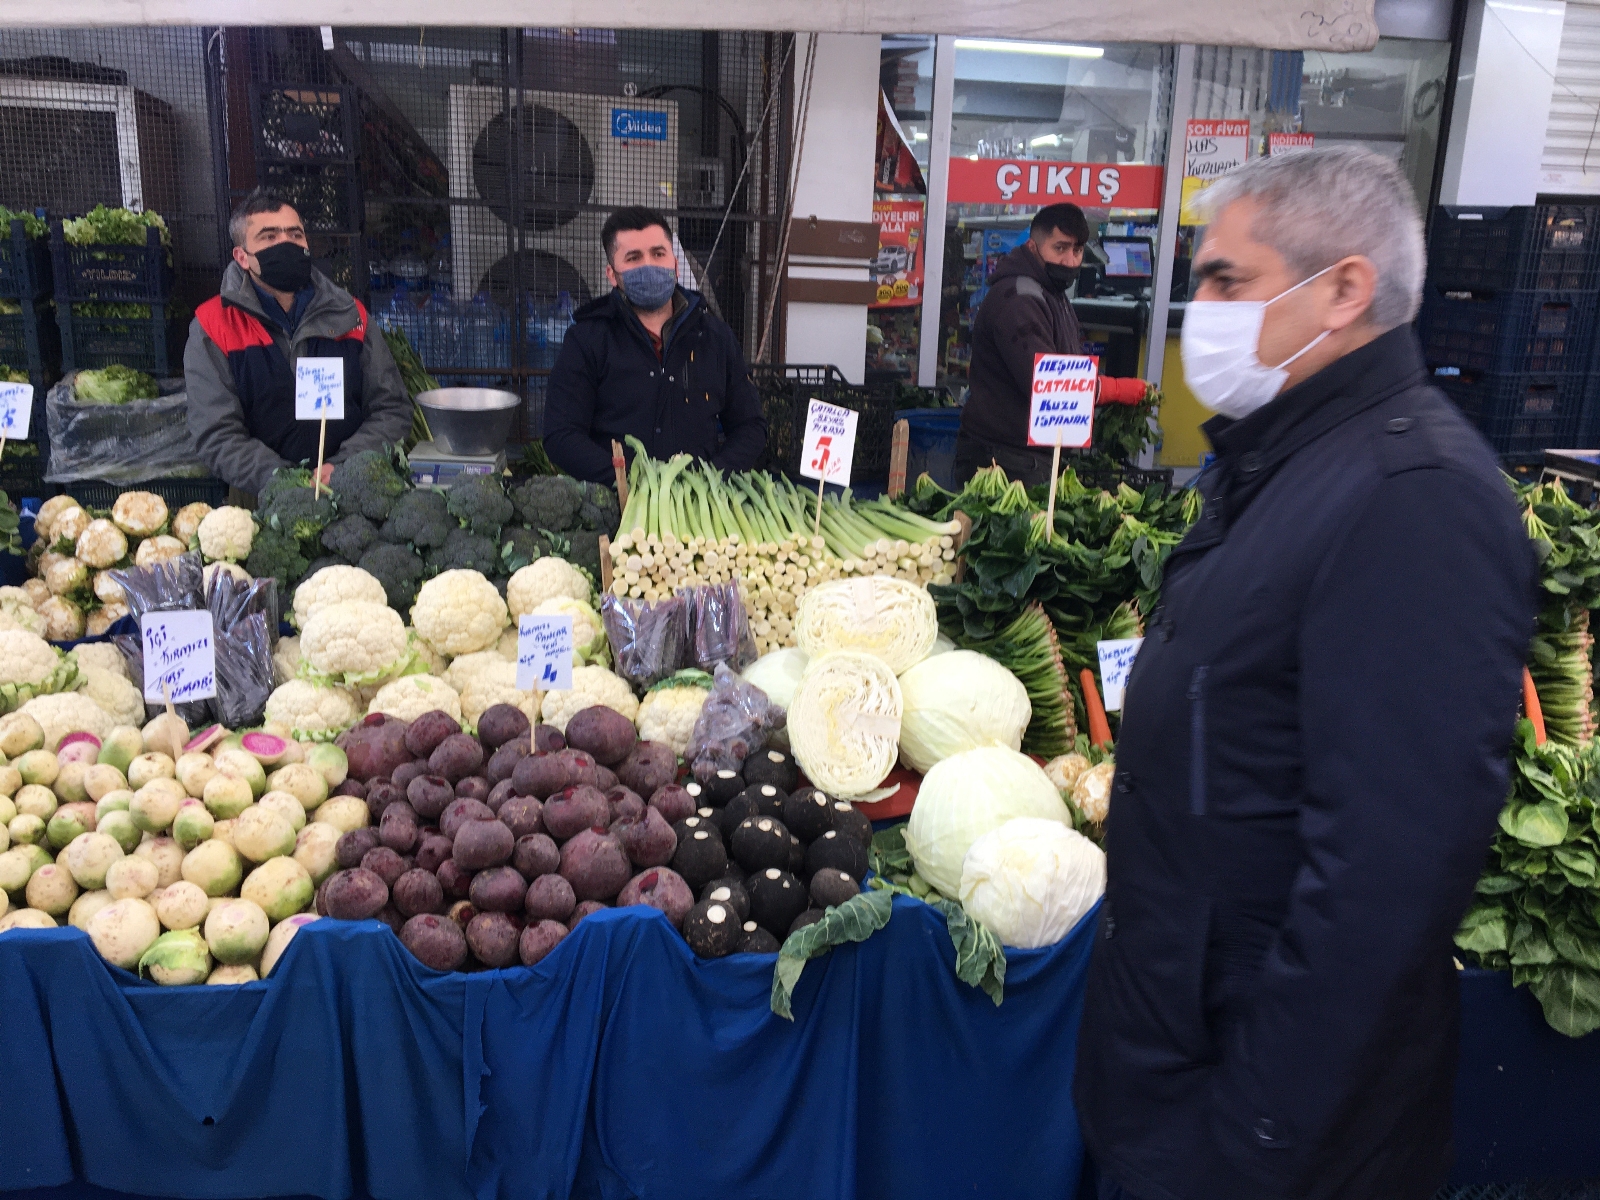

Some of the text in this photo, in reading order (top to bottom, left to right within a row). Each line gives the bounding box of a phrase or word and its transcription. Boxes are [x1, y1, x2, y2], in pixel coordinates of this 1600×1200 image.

[617, 113, 661, 134] Midea
[1216, 121, 1248, 135] FİYAT
[996, 164, 1120, 204] ÇIKIŞ
[873, 211, 920, 222] DİYELERİ
[811, 436, 832, 471] 5
[160, 637, 208, 665] KIRMIZI
